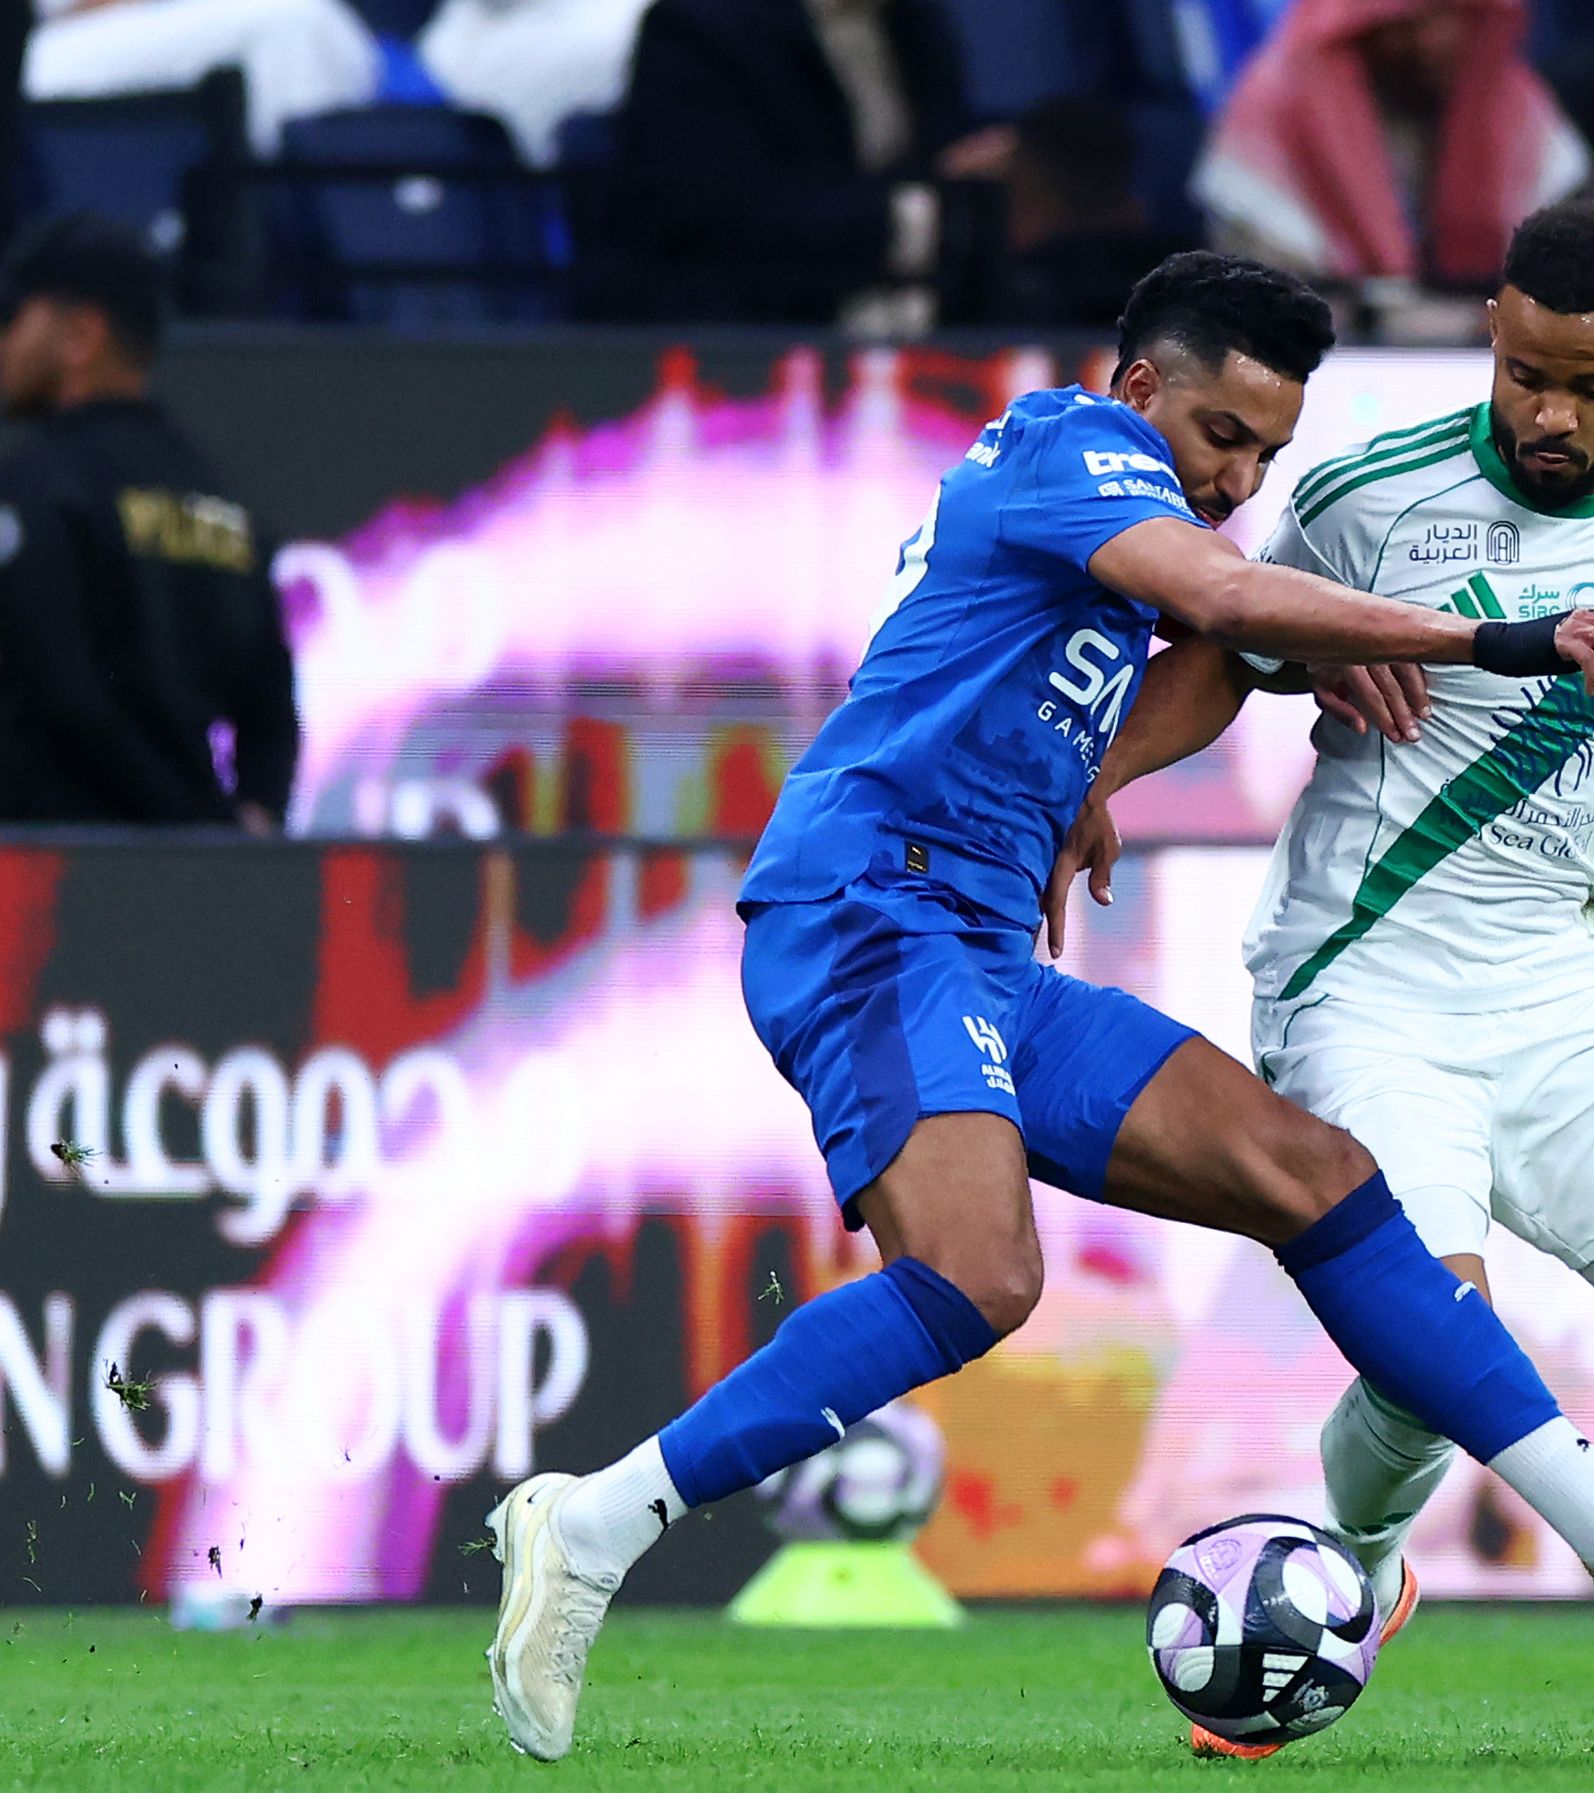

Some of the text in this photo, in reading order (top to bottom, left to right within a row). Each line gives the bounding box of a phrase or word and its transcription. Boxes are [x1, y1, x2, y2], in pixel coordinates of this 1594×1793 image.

[1425, 523, 1478, 544] الديار
[1408, 544, 1478, 564] العربية
[1518, 583, 1560, 604] سرك
[1490, 824, 1534, 851] Sea
[92, 1286, 588, 1482] GROUP
